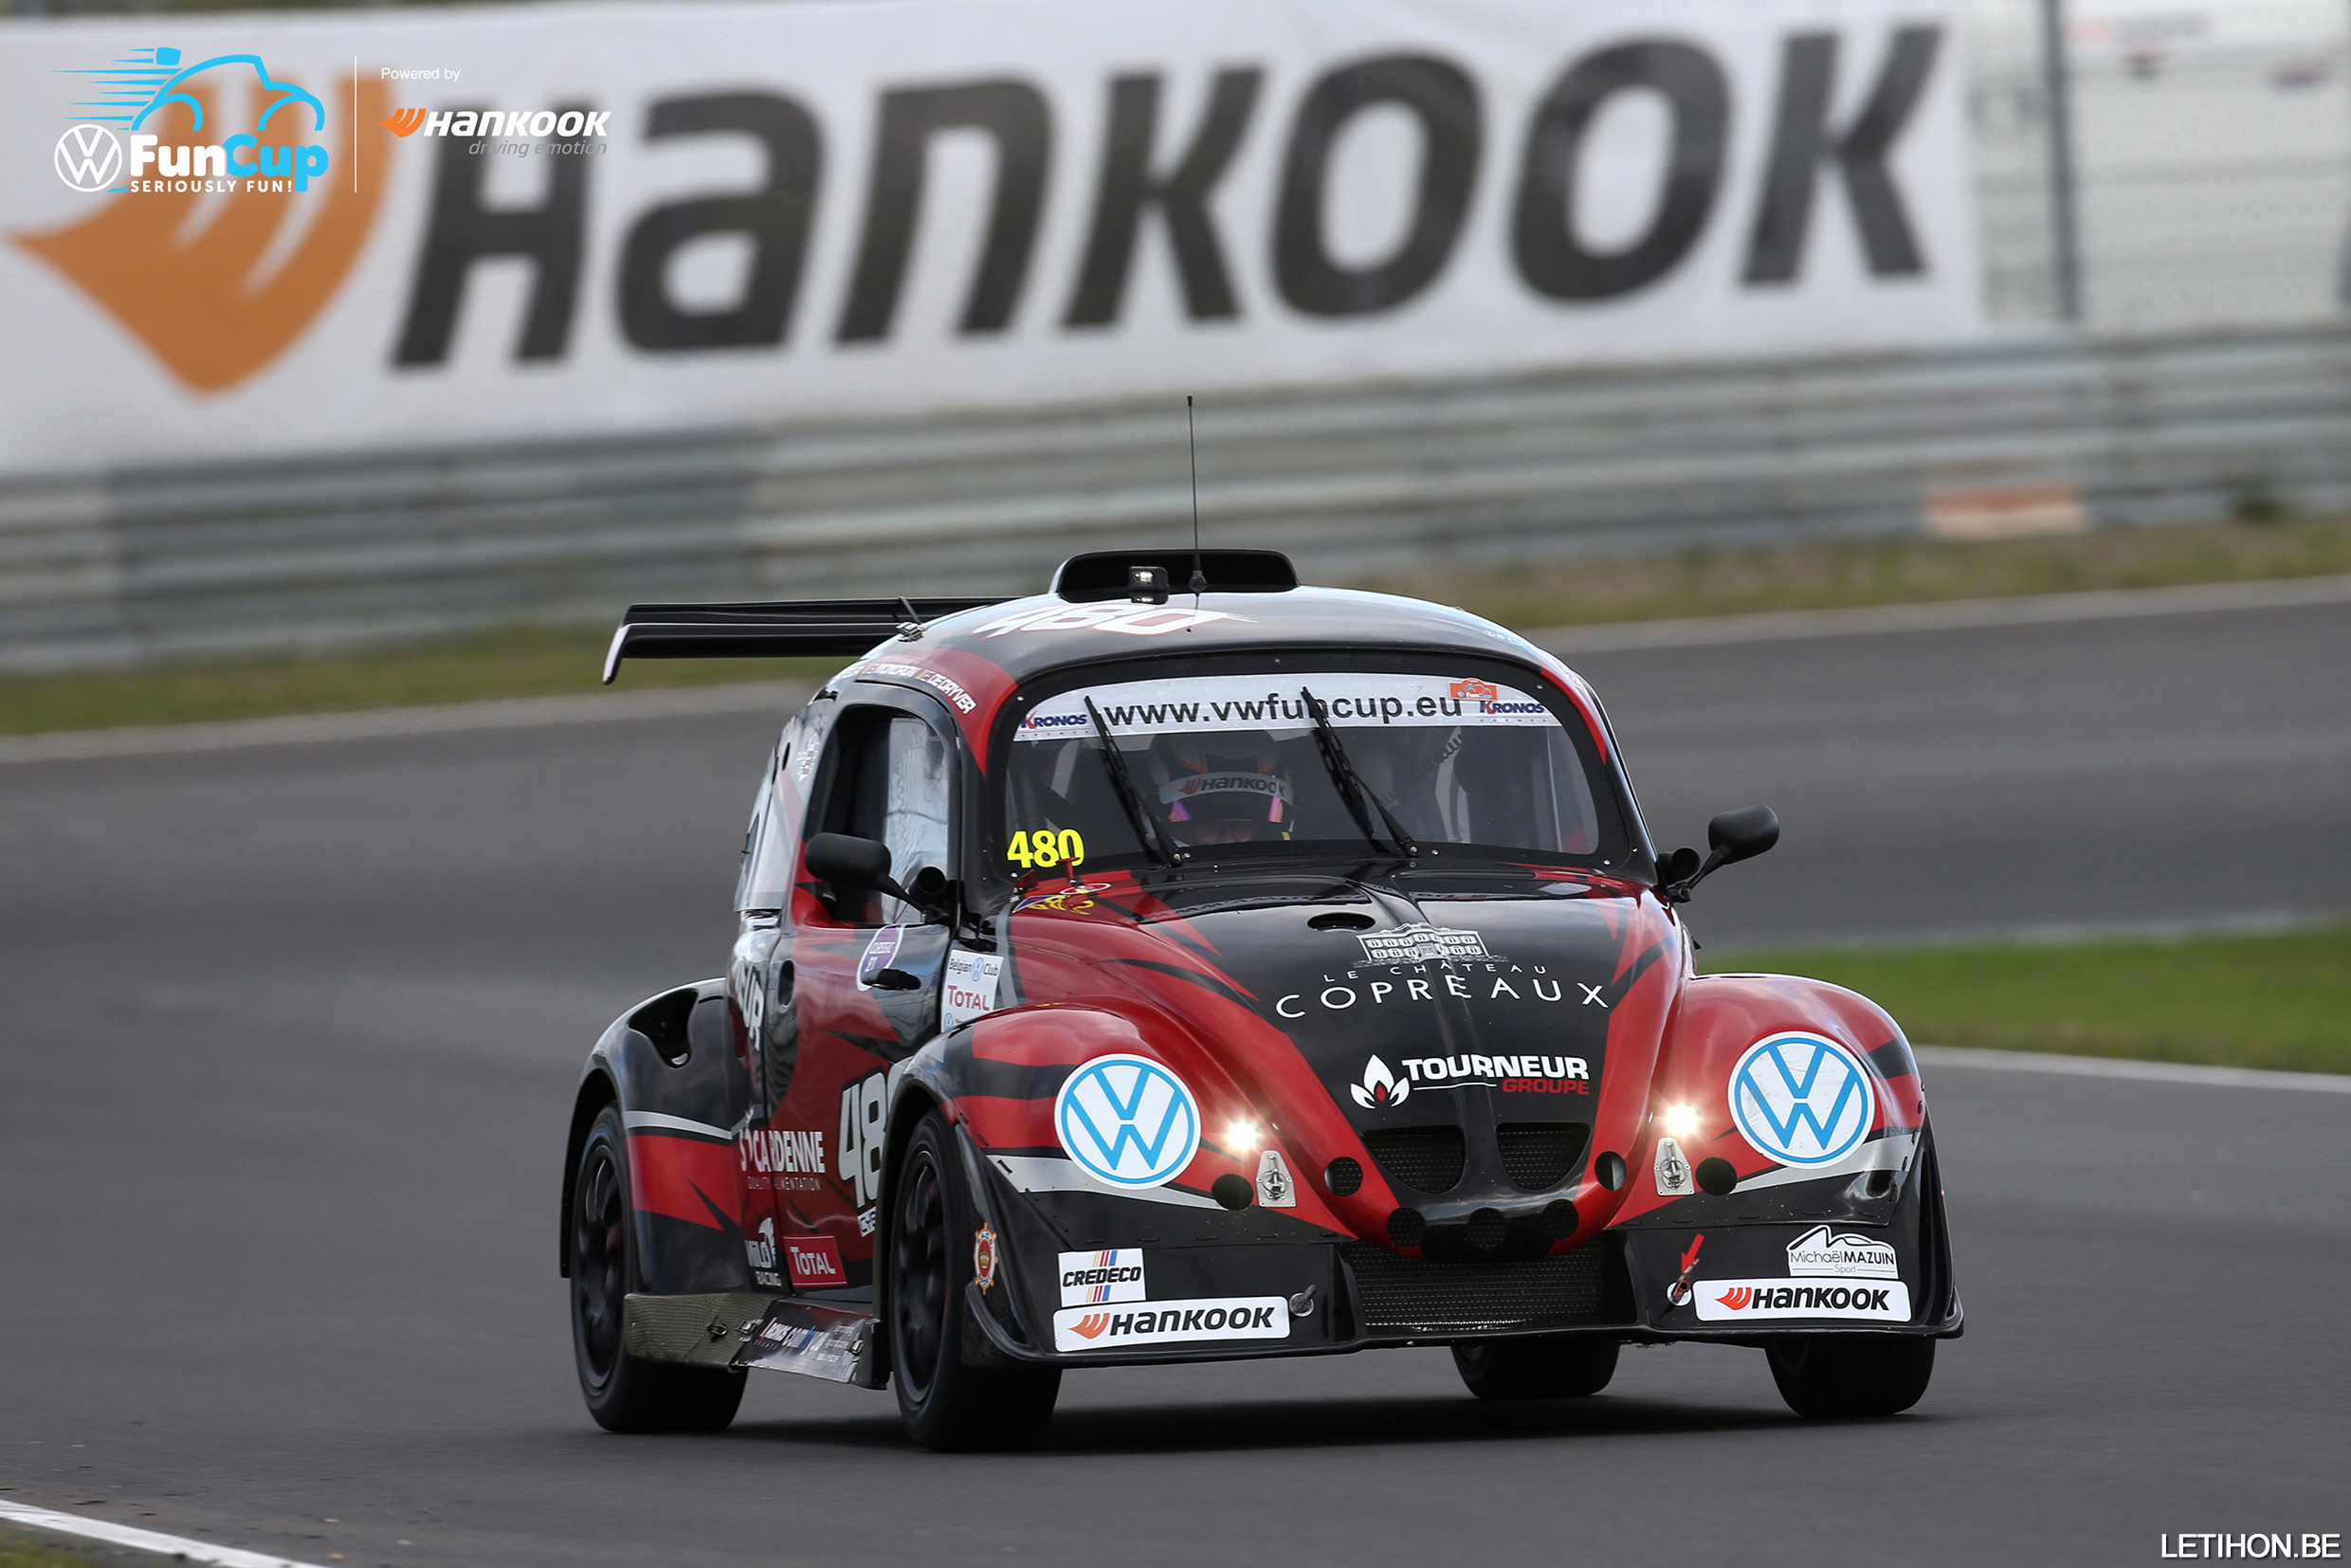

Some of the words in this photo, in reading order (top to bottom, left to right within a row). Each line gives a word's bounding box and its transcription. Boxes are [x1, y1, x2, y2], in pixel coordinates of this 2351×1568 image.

[1103, 692, 1462, 726] www.vwfuncup.eu
[1480, 701, 1545, 715] KRONOS
[1021, 711, 1087, 729] KRONOS
[1007, 829, 1084, 868] 480
[949, 957, 972, 975] Belgian
[984, 962, 998, 976] Club
[1323, 969, 1358, 983] LE
[1390, 960, 1547, 975] CHÂTEAU
[948, 985, 990, 1012] TOTAL
[1276, 974, 1609, 1019] COPREAUX
[1402, 1053, 1590, 1081] TOURNEUR
[1502, 1079, 1590, 1095] GROUPE
[790, 1247, 836, 1275] TOTAL
[1834, 1265, 1856, 1274] Sport
[1063, 1267, 1142, 1287] CREDECO
